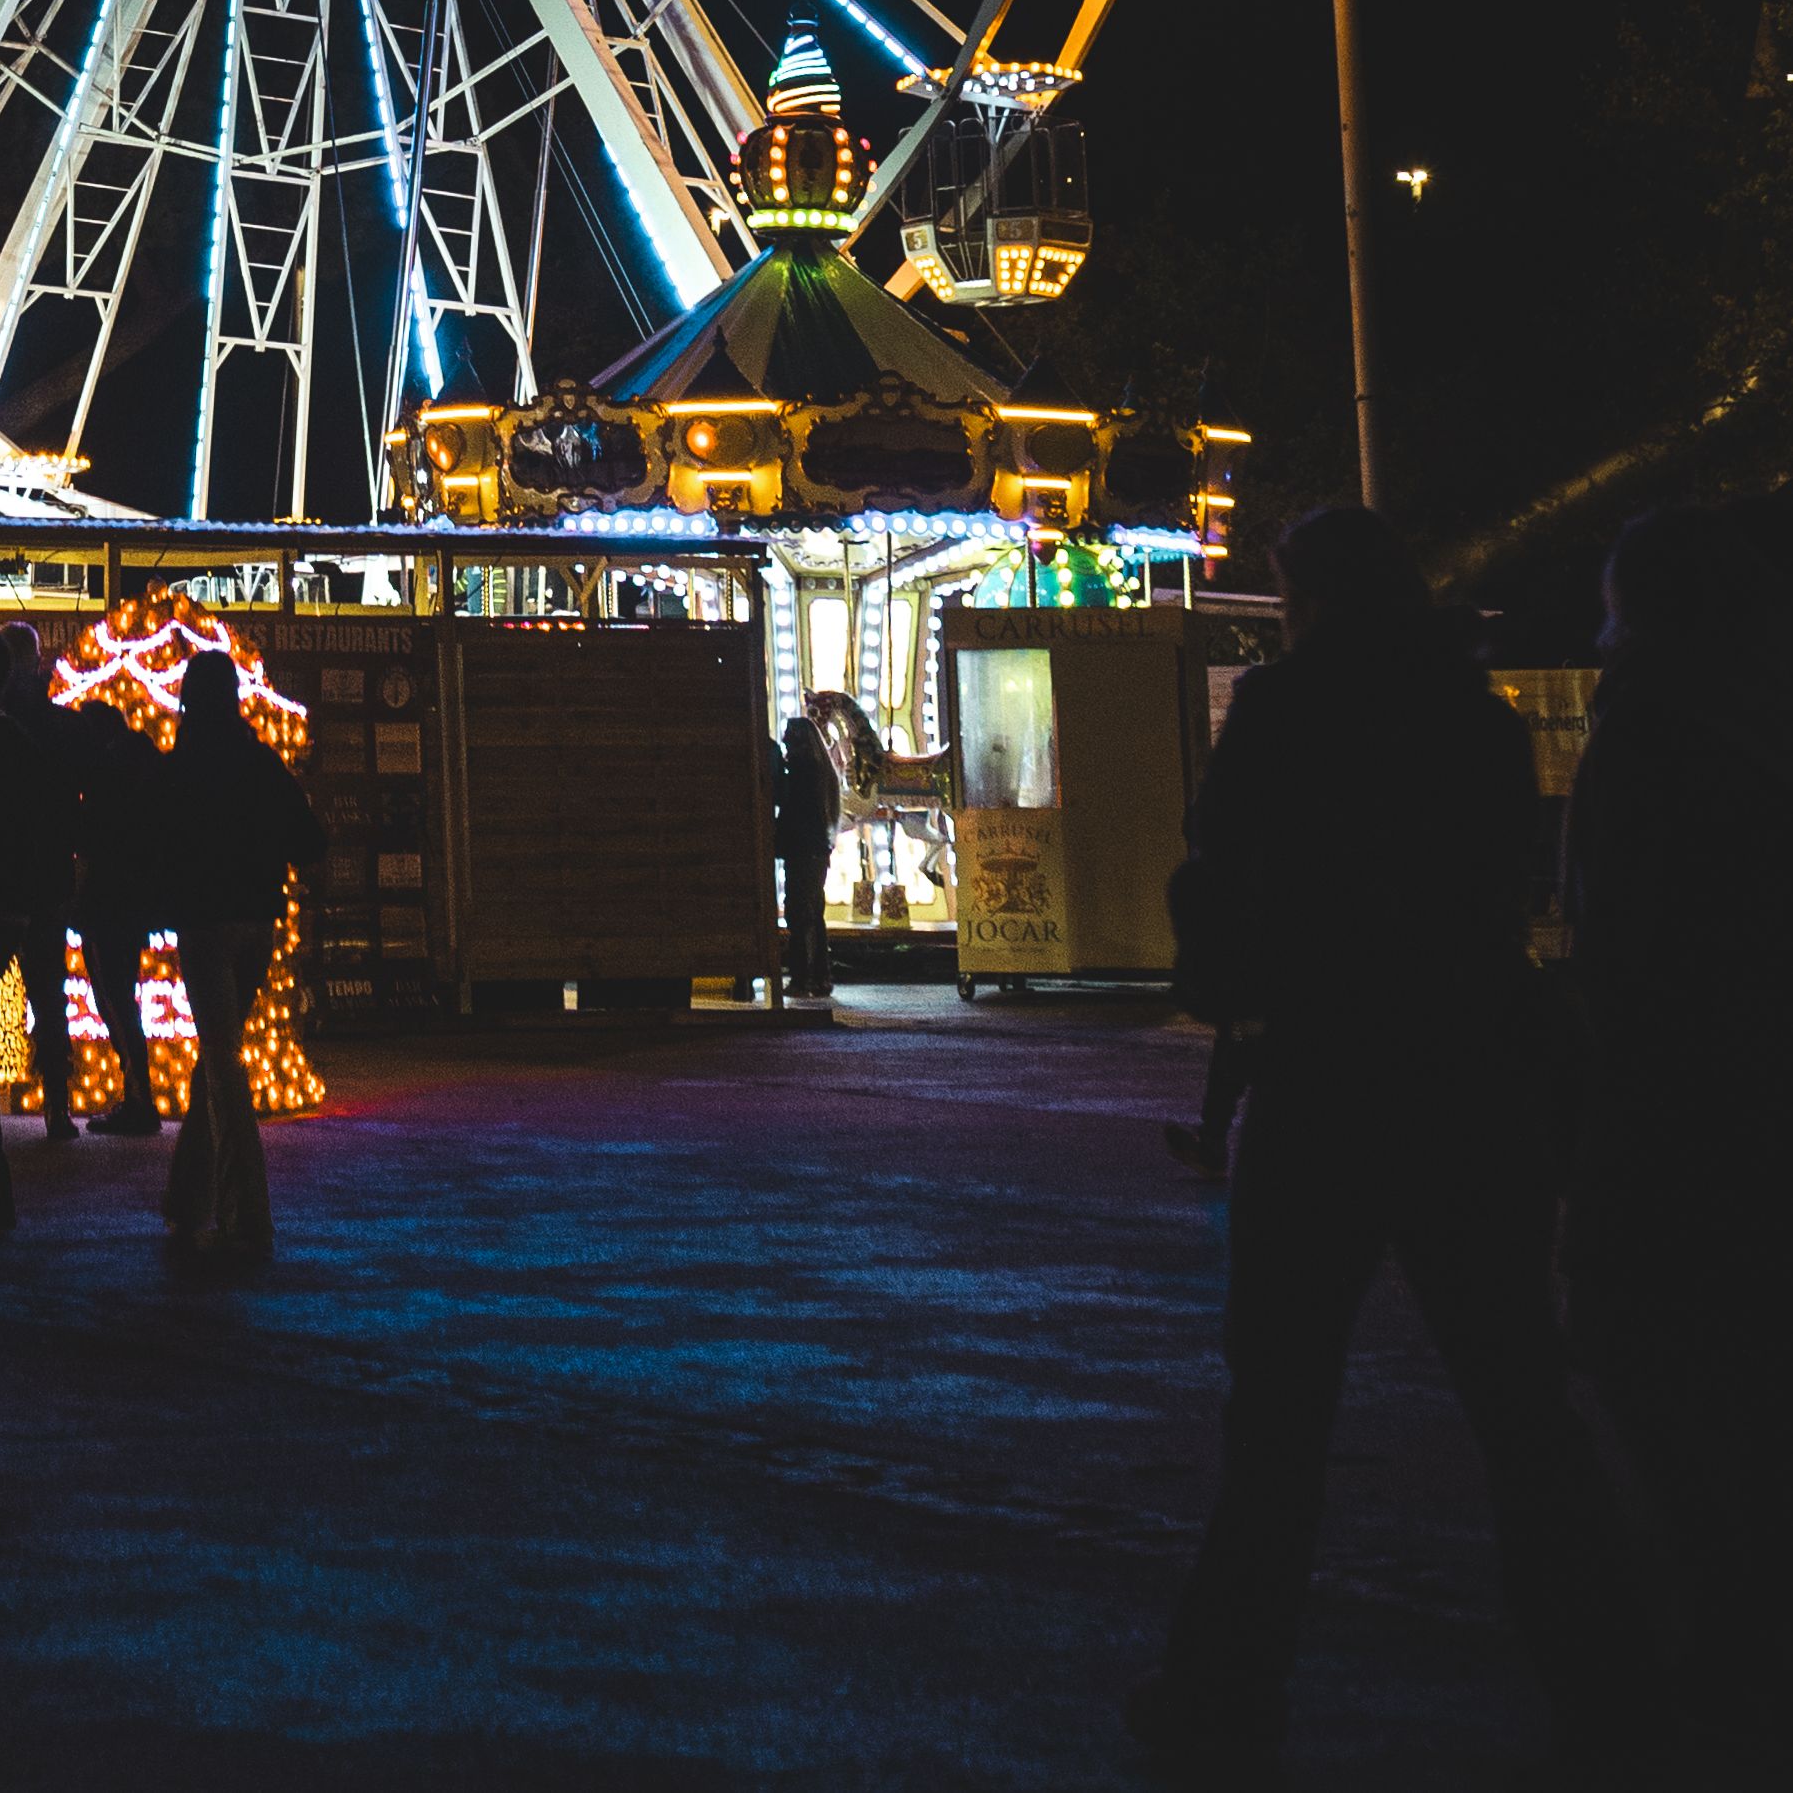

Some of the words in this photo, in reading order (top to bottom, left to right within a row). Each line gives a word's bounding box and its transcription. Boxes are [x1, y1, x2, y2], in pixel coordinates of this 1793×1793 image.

[1010, 221, 1022, 238] 5
[912, 232, 922, 249] 5
[975, 614, 1155, 640] CARRUSEL
[274, 622, 412, 654] RESTAURANTS
[963, 824, 1053, 844] CARRUSEL
[966, 919, 1063, 948] JOCAR
[326, 980, 373, 997] TEMPO
